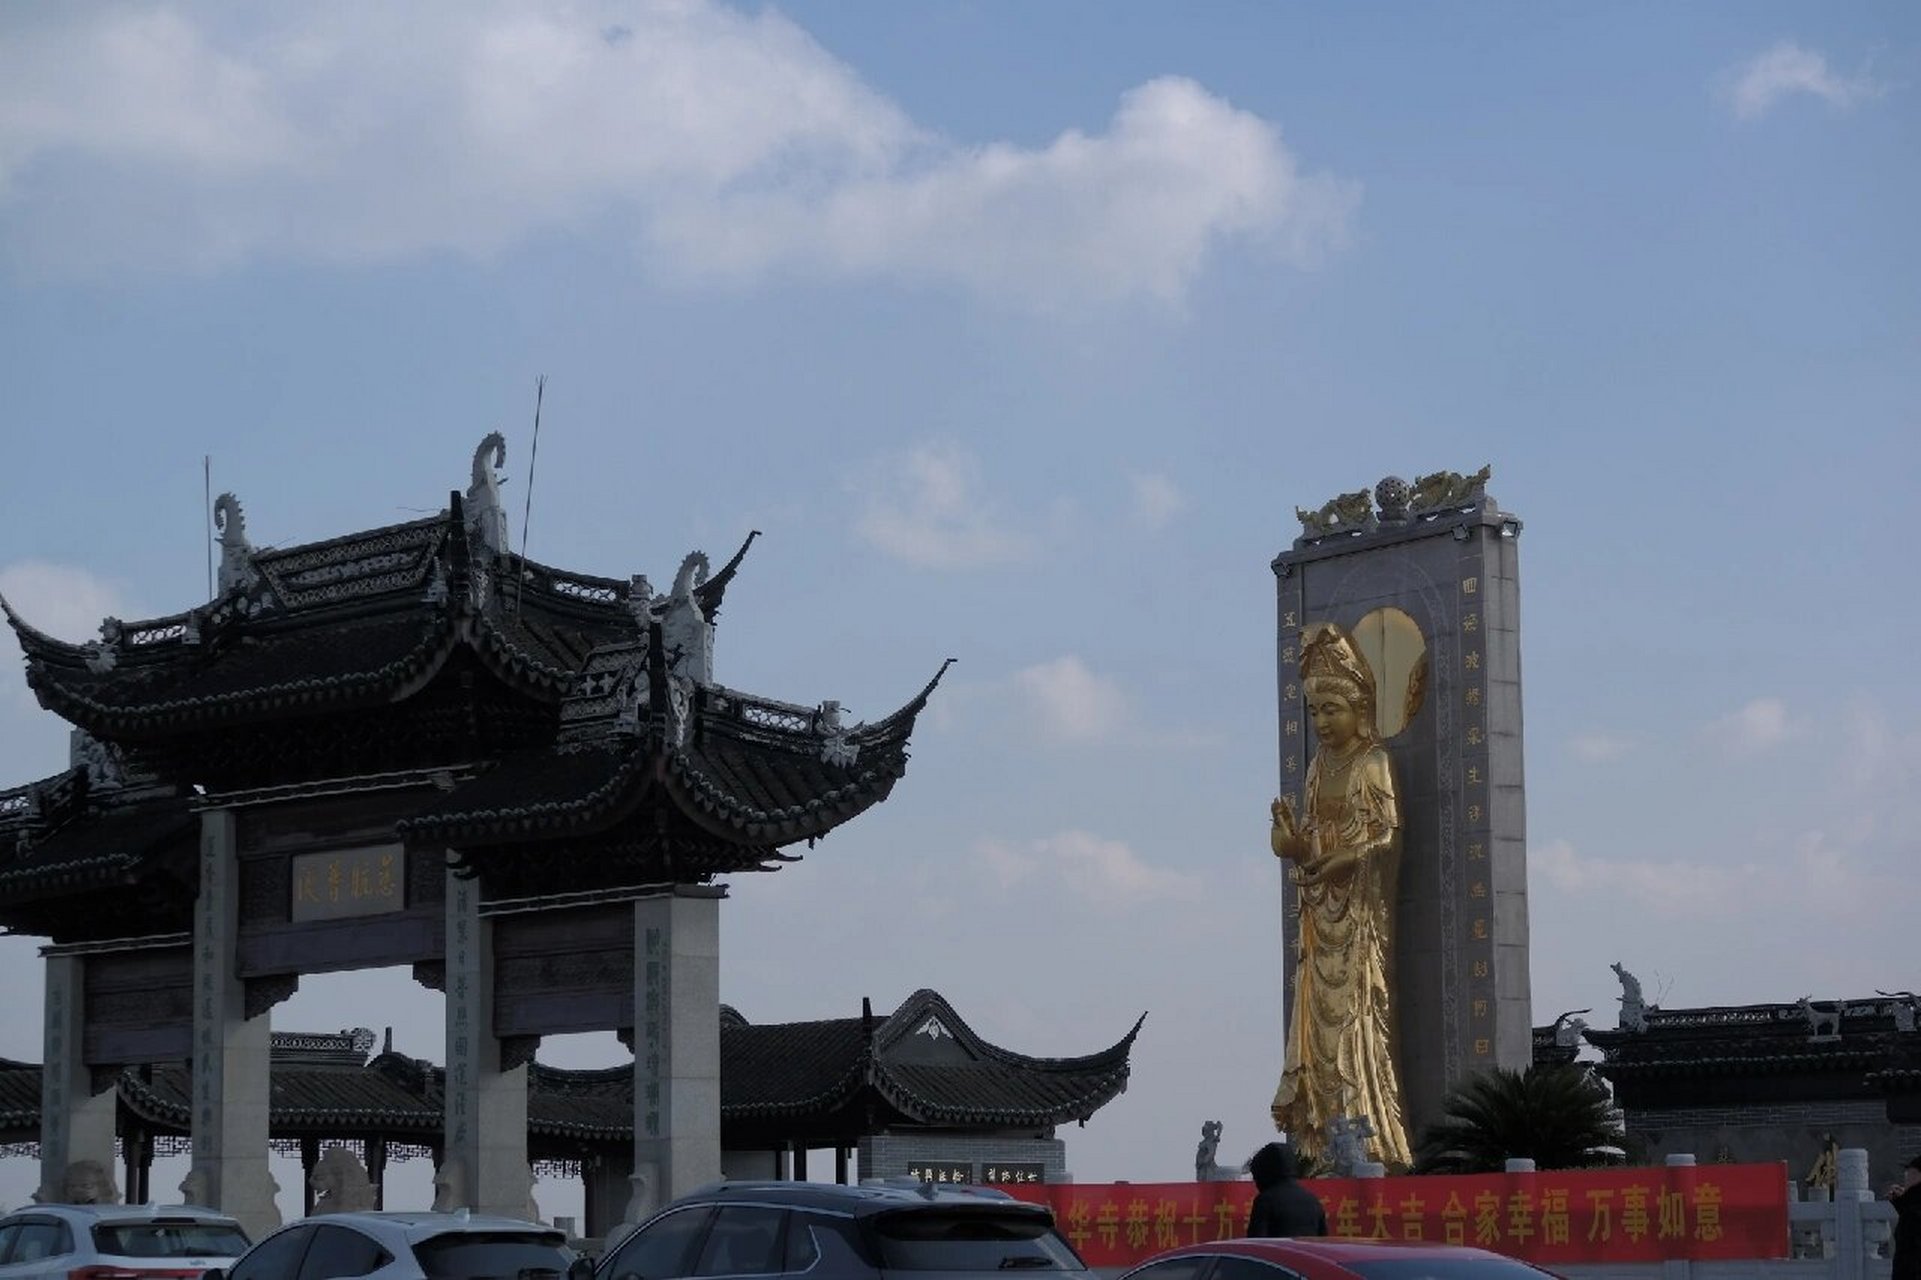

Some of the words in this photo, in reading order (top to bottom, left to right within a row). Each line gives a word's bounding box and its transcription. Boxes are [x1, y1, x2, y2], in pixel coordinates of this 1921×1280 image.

[1442, 1188, 1571, 1246] 合家幸福
[1586, 1182, 1724, 1245] 万事如意
